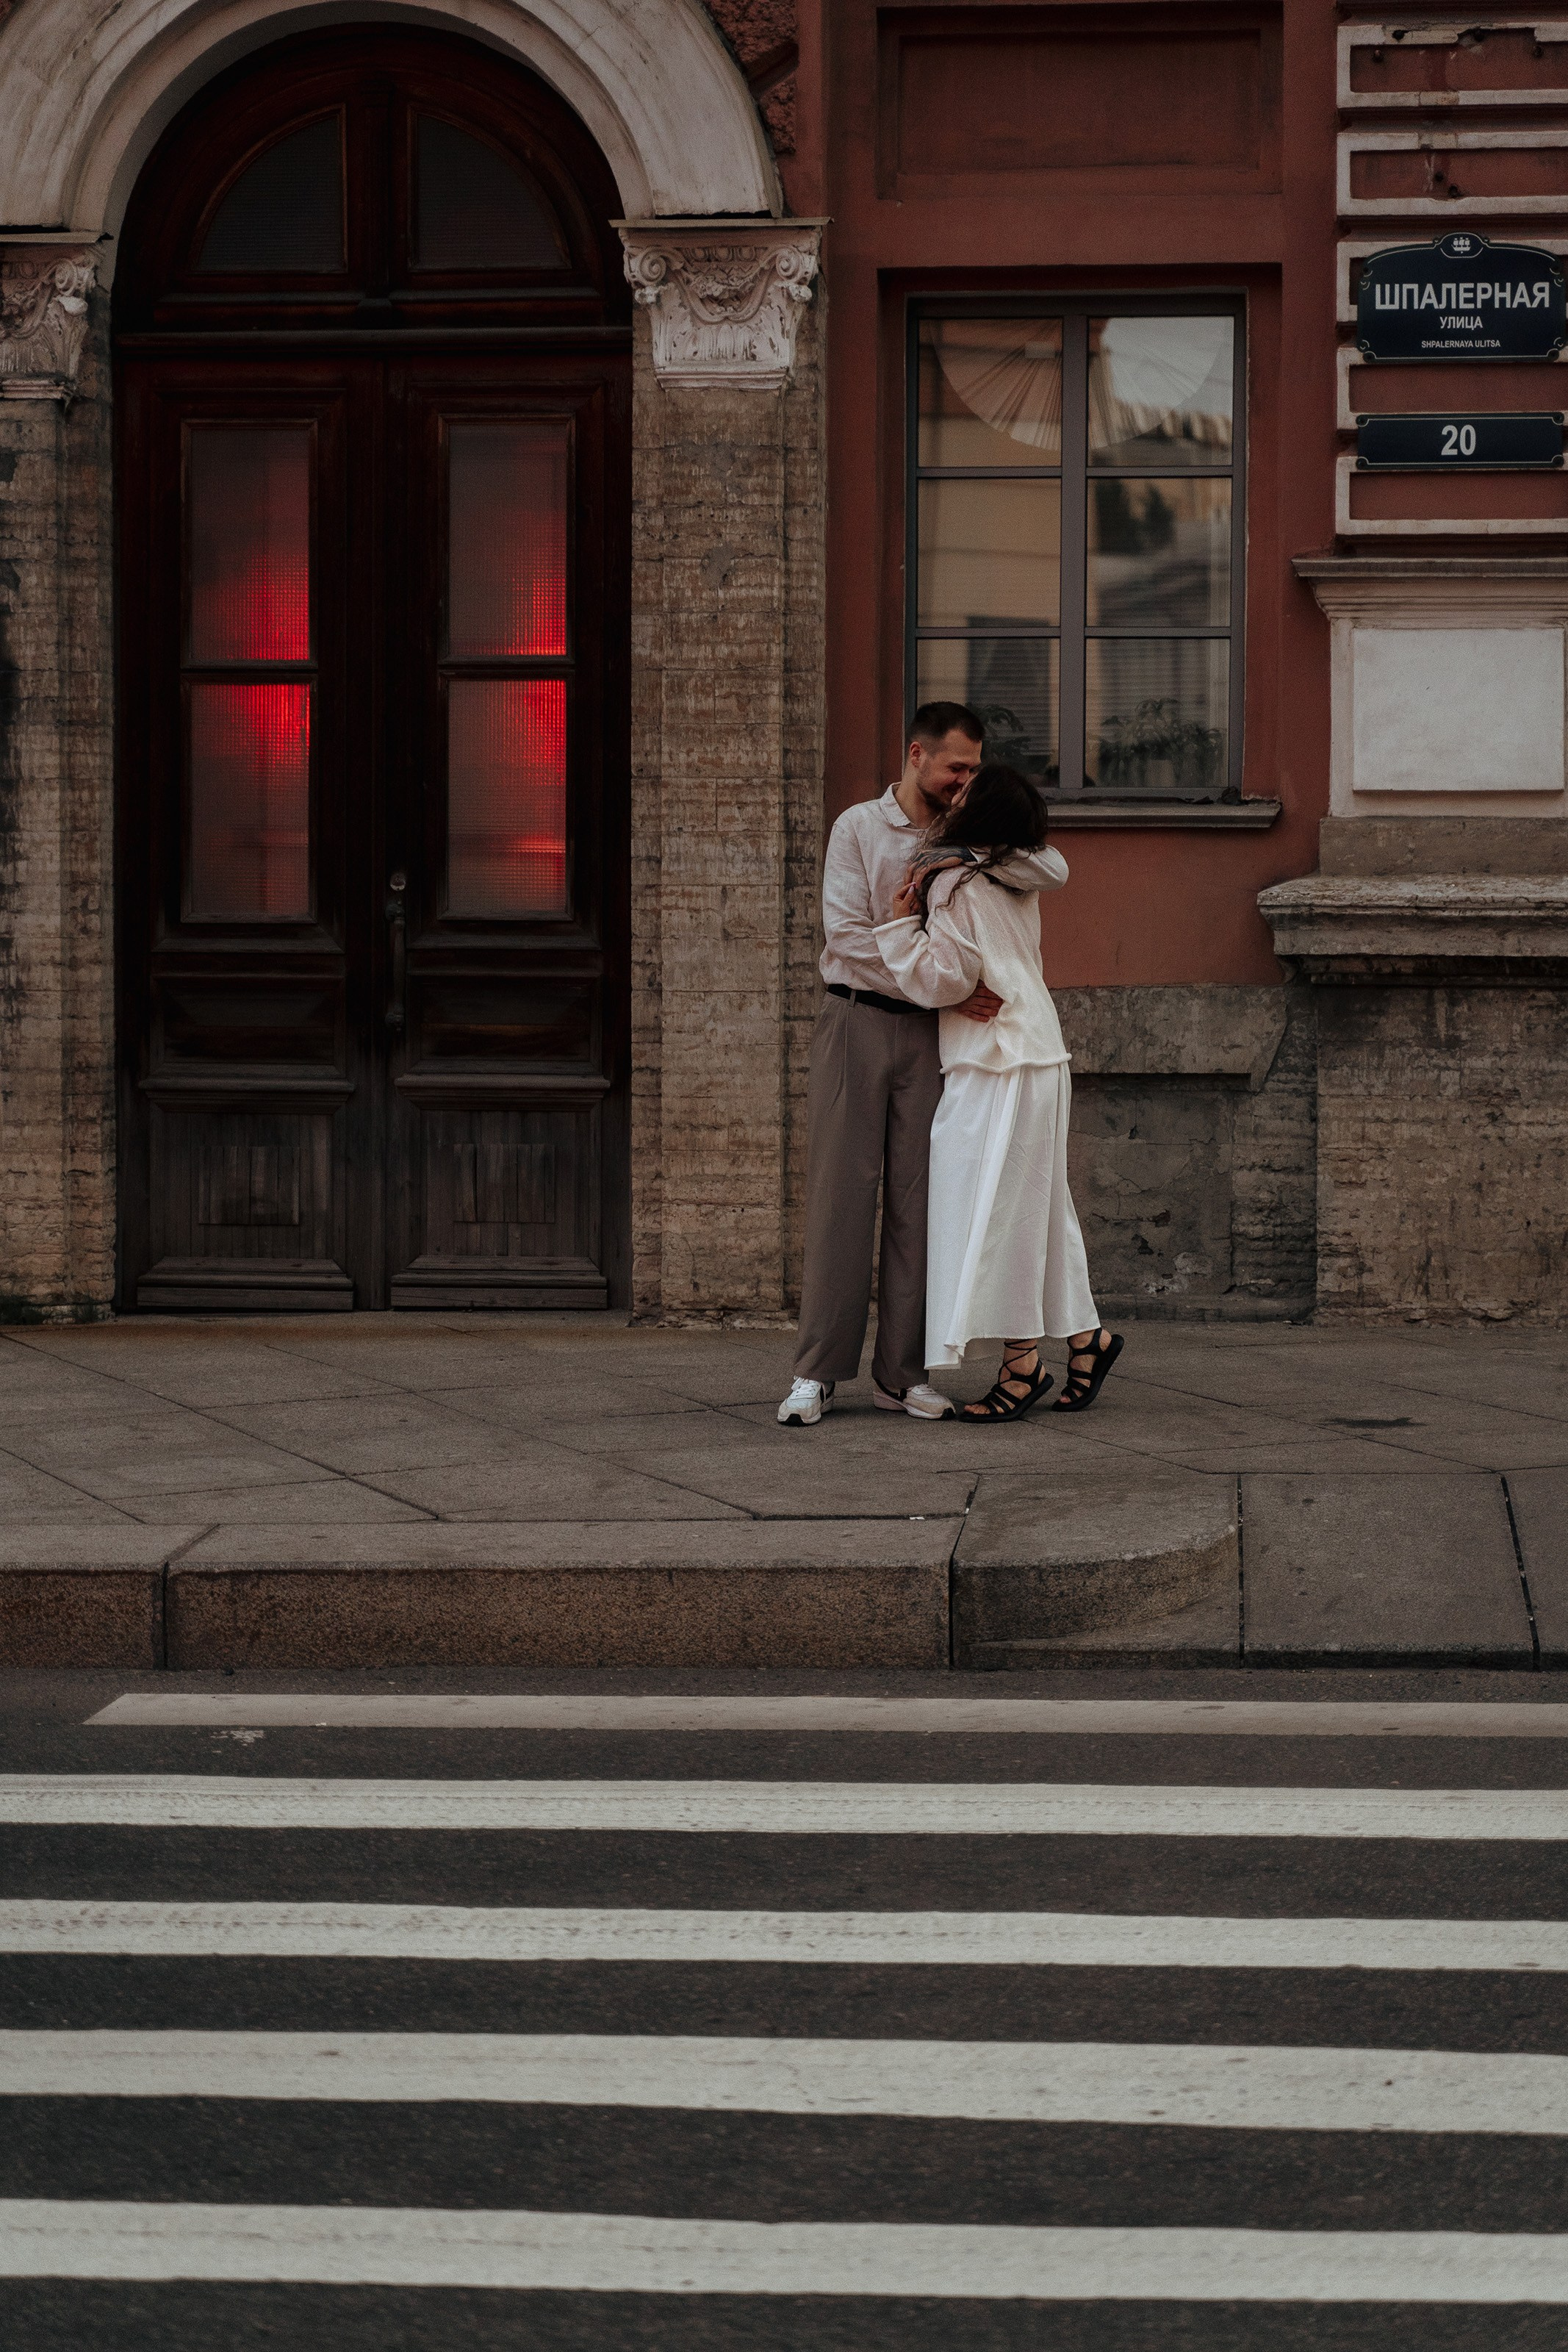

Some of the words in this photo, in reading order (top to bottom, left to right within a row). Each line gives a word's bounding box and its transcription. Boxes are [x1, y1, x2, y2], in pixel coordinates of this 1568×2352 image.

[1375, 282, 1550, 309] ШПАЛЕРНАЯ
[1439, 315, 1484, 330] УЛИЦА
[1421, 340, 1473, 348] SHPALERNAYA
[1475, 340, 1501, 348] ULITSA
[1441, 424, 1476, 456] 20
